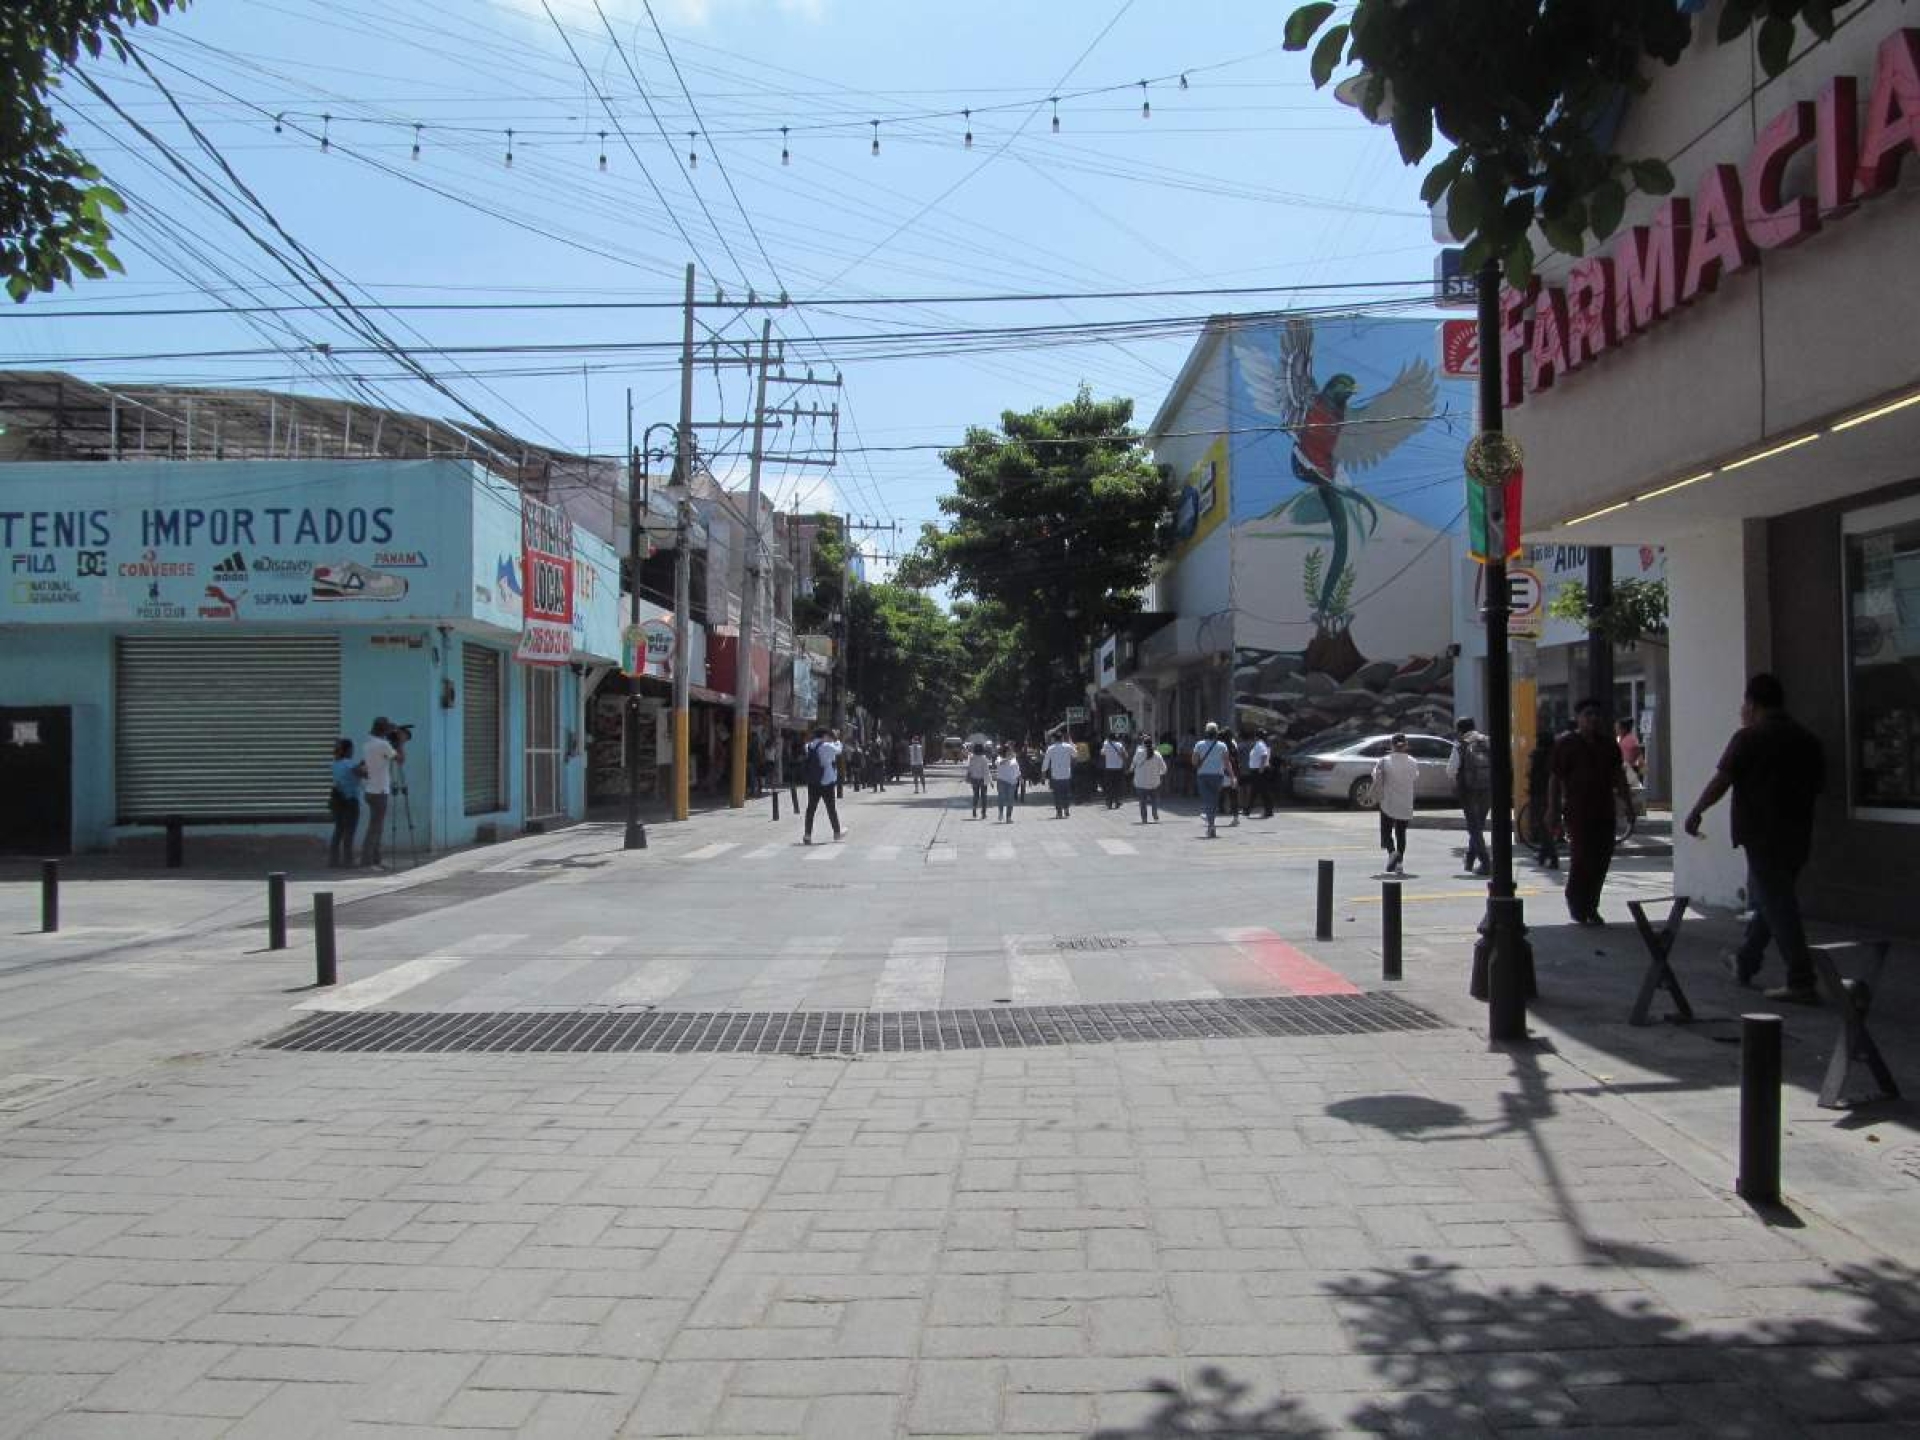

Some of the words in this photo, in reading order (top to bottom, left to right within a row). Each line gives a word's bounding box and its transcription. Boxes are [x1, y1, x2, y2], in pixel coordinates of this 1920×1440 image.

[1500, 27, 1920, 409] FARMACIA
[1, 509, 110, 548] TENIS
[142, 507, 394, 547] IMPORTADOS
[12, 554, 57, 574] FILA
[77, 550, 107, 577] DC
[118, 562, 196, 577] CONVERSE
[374, 552, 417, 564] PANAM
